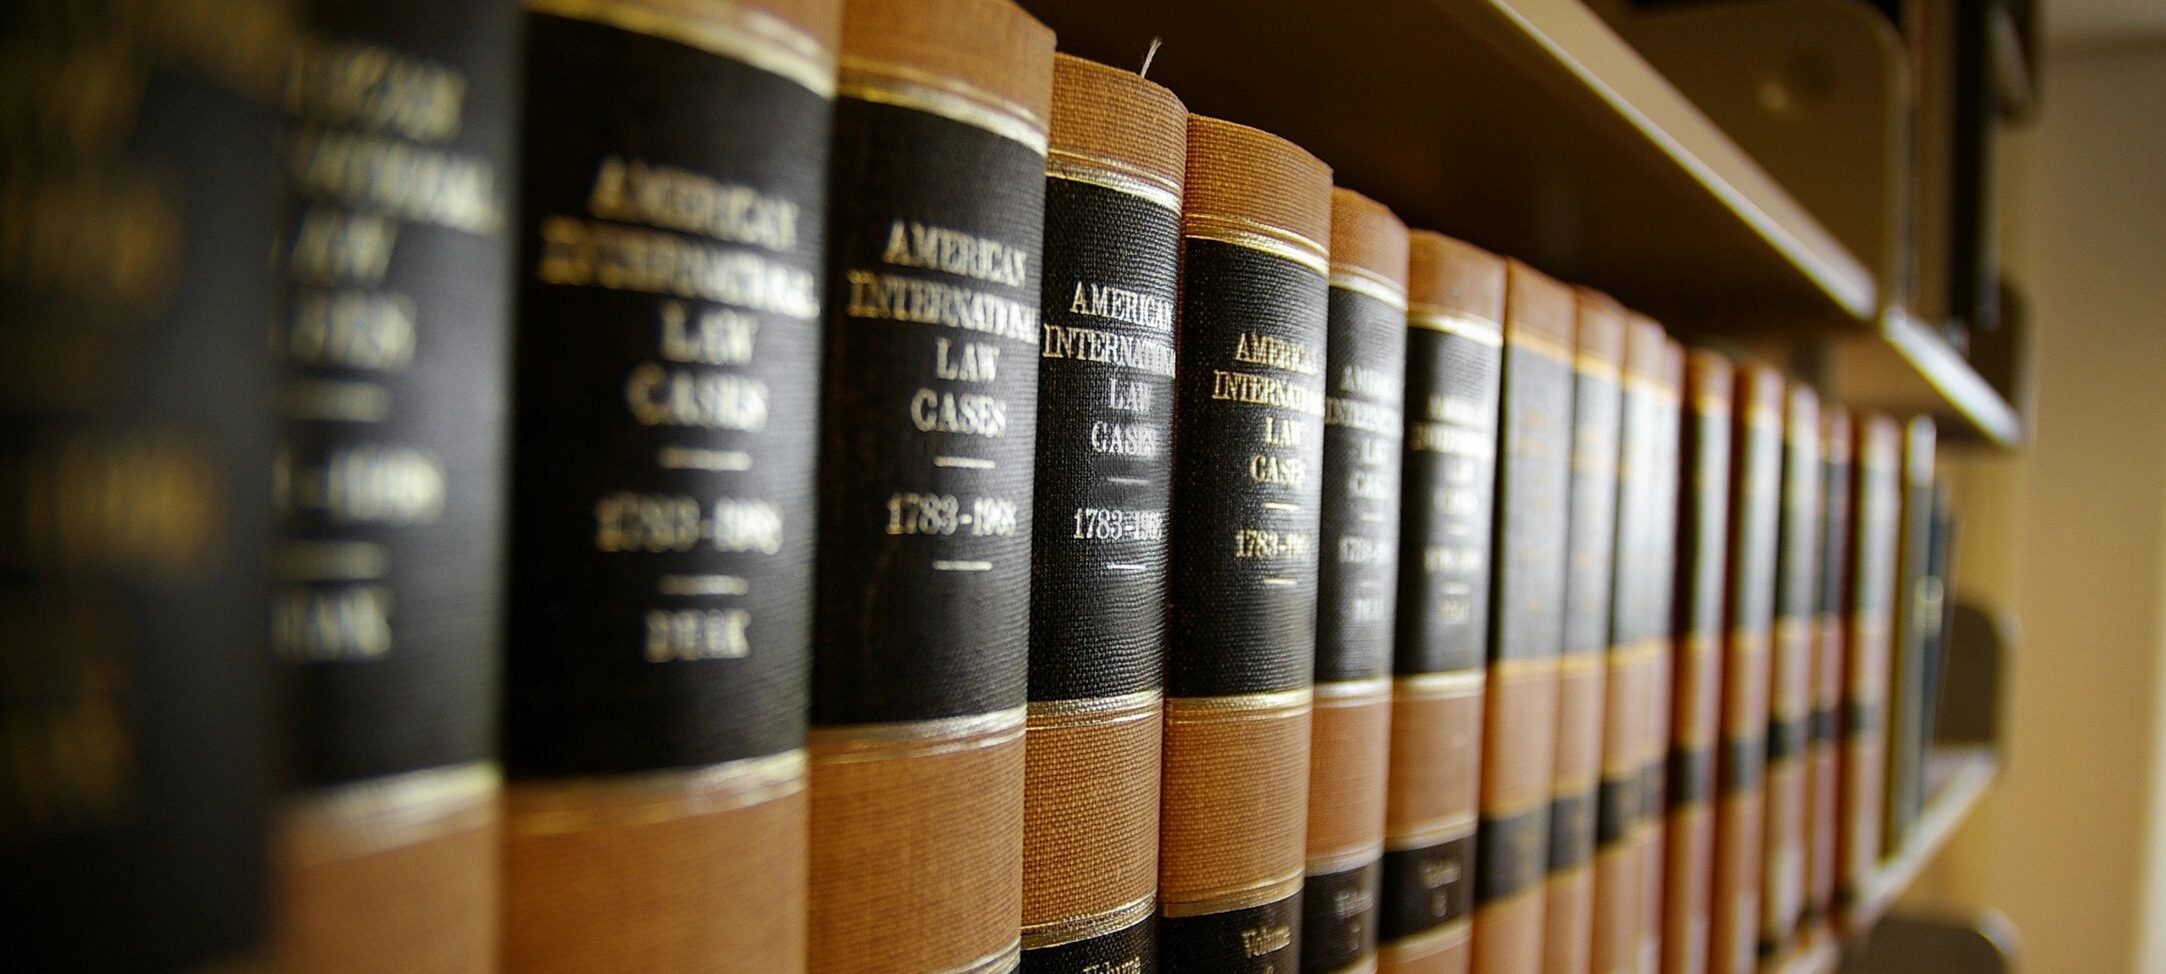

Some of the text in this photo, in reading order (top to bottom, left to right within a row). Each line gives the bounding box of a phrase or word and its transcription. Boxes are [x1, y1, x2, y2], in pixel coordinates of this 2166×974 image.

[882, 220, 1026, 288] AMERICAN
[936, 336, 1000, 383] LAW
[911, 388, 1006, 438] CASES
[1109, 378, 1152, 412] LAW
[1091, 421, 1156, 459] CASES
